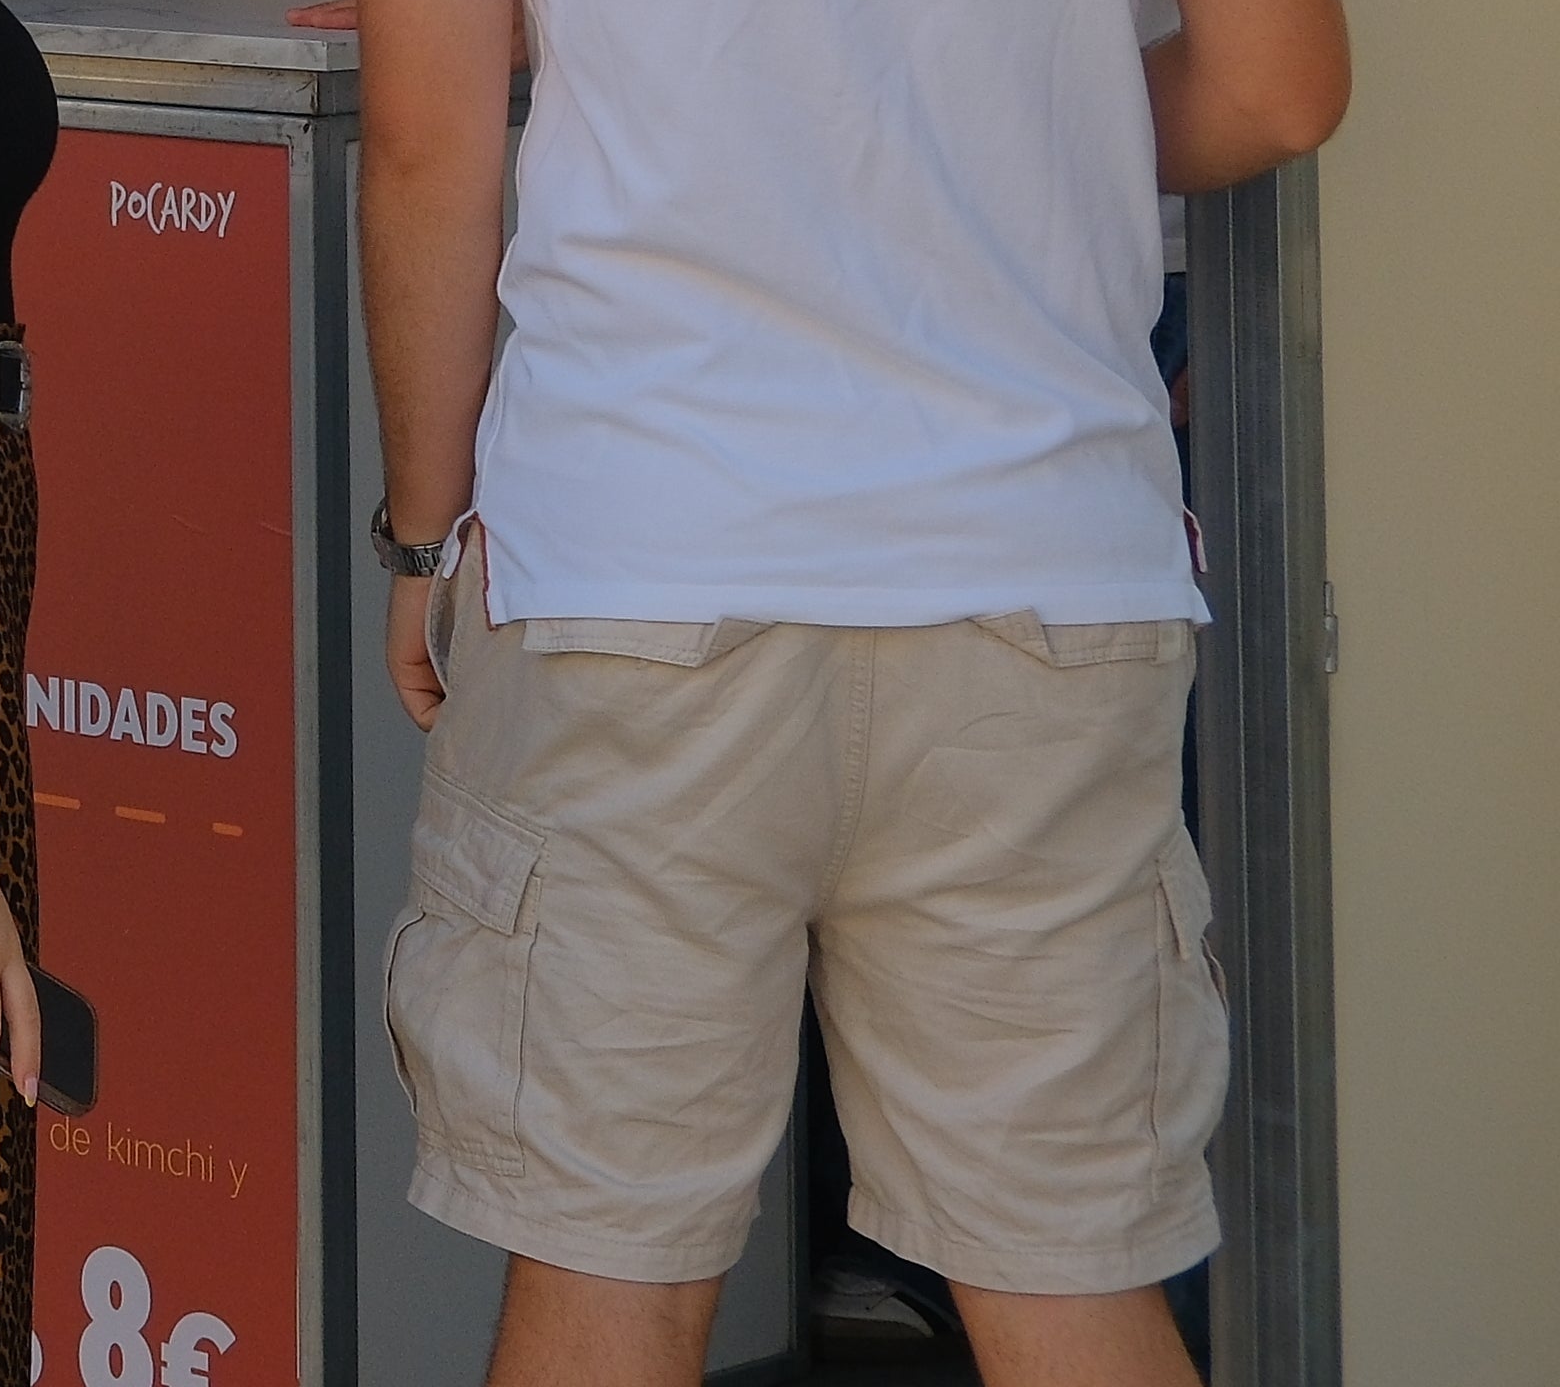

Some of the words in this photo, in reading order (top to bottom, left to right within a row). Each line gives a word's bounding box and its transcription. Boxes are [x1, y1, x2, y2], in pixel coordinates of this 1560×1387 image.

[26, 673, 238, 758] NIDADES
[49, 1117, 91, 1157] de
[107, 1121, 216, 1184] kimchi
[229, 1157, 249, 1199] y
